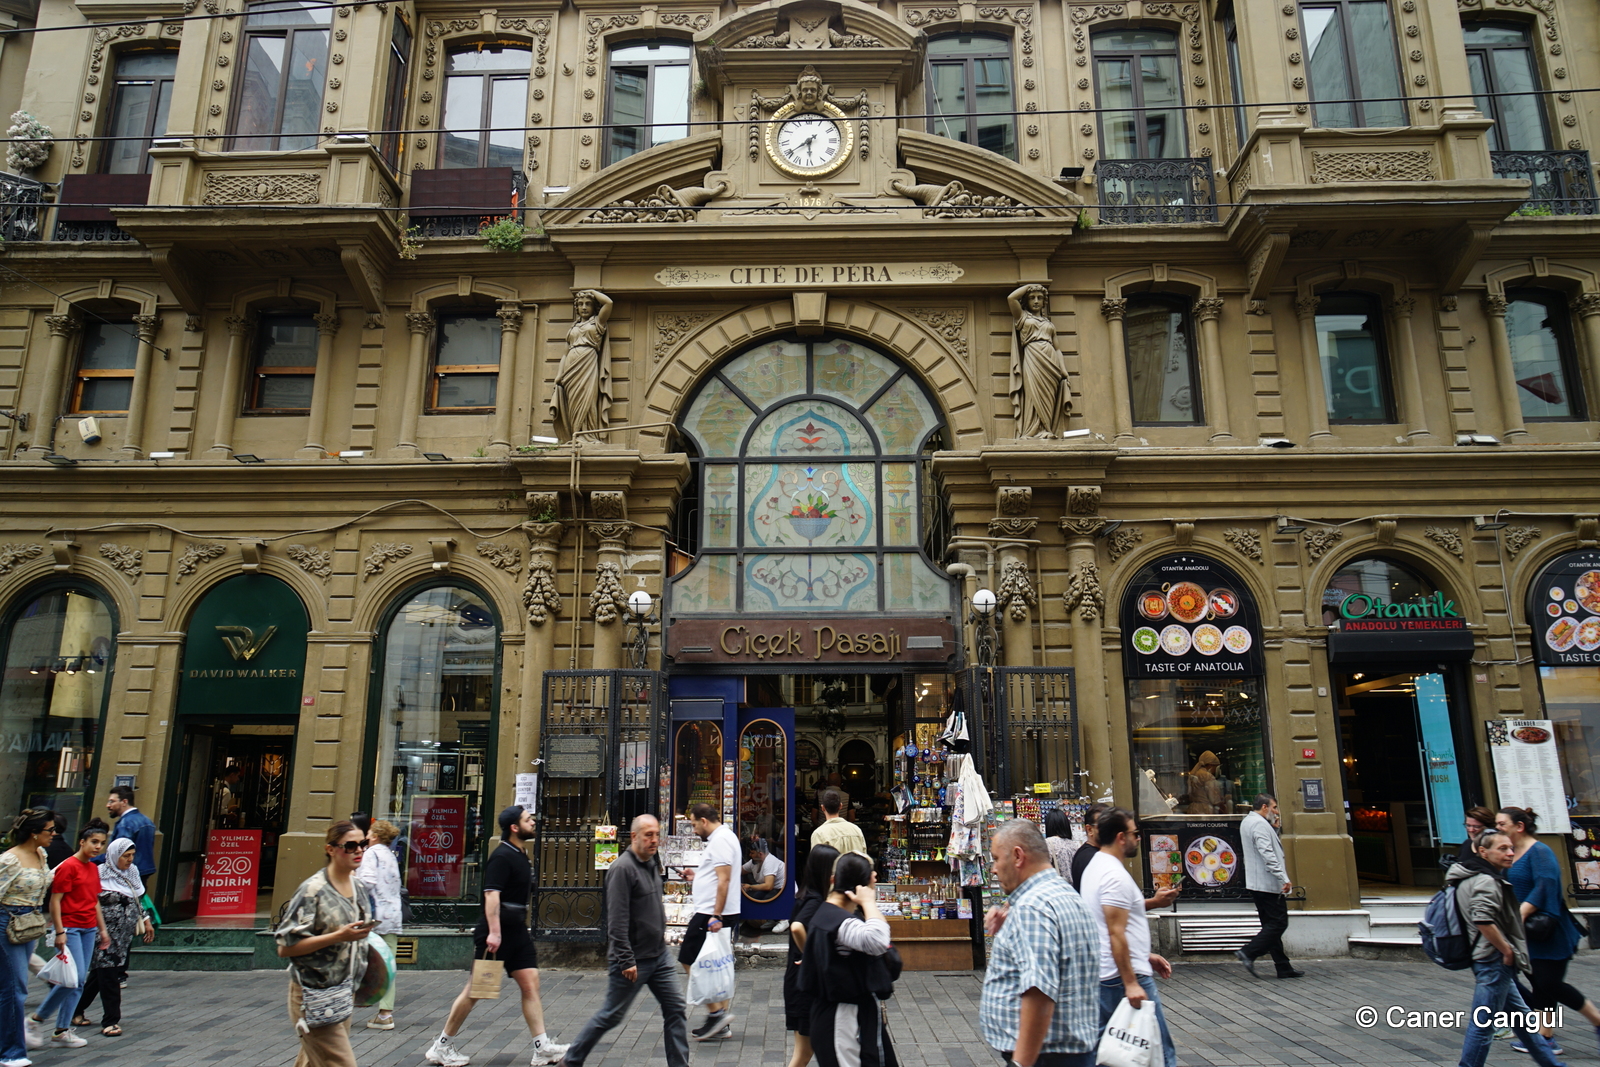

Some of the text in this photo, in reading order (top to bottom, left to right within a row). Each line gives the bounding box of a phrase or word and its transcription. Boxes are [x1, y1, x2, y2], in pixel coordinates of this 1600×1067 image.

[800, 198, 822, 207] 1876
[730, 264, 893, 284] CITÉ DE PÉRA
[1338, 590, 1458, 619] Otantik
[1345, 621, 1397, 630] ANADOLU
[1559, 653, 1590, 662] TASTE
[1145, 662, 1244, 672] TASTE OF ANATOLIA
[1430, 774, 1449, 783] PUSH
[420, 831, 454, 848] %20
[415, 852, 457, 864] İNDİRİM
[204, 856, 252, 875] %20
[201, 876, 252, 888] İNDİRİM
[210, 895, 240, 903] HEDİYE
